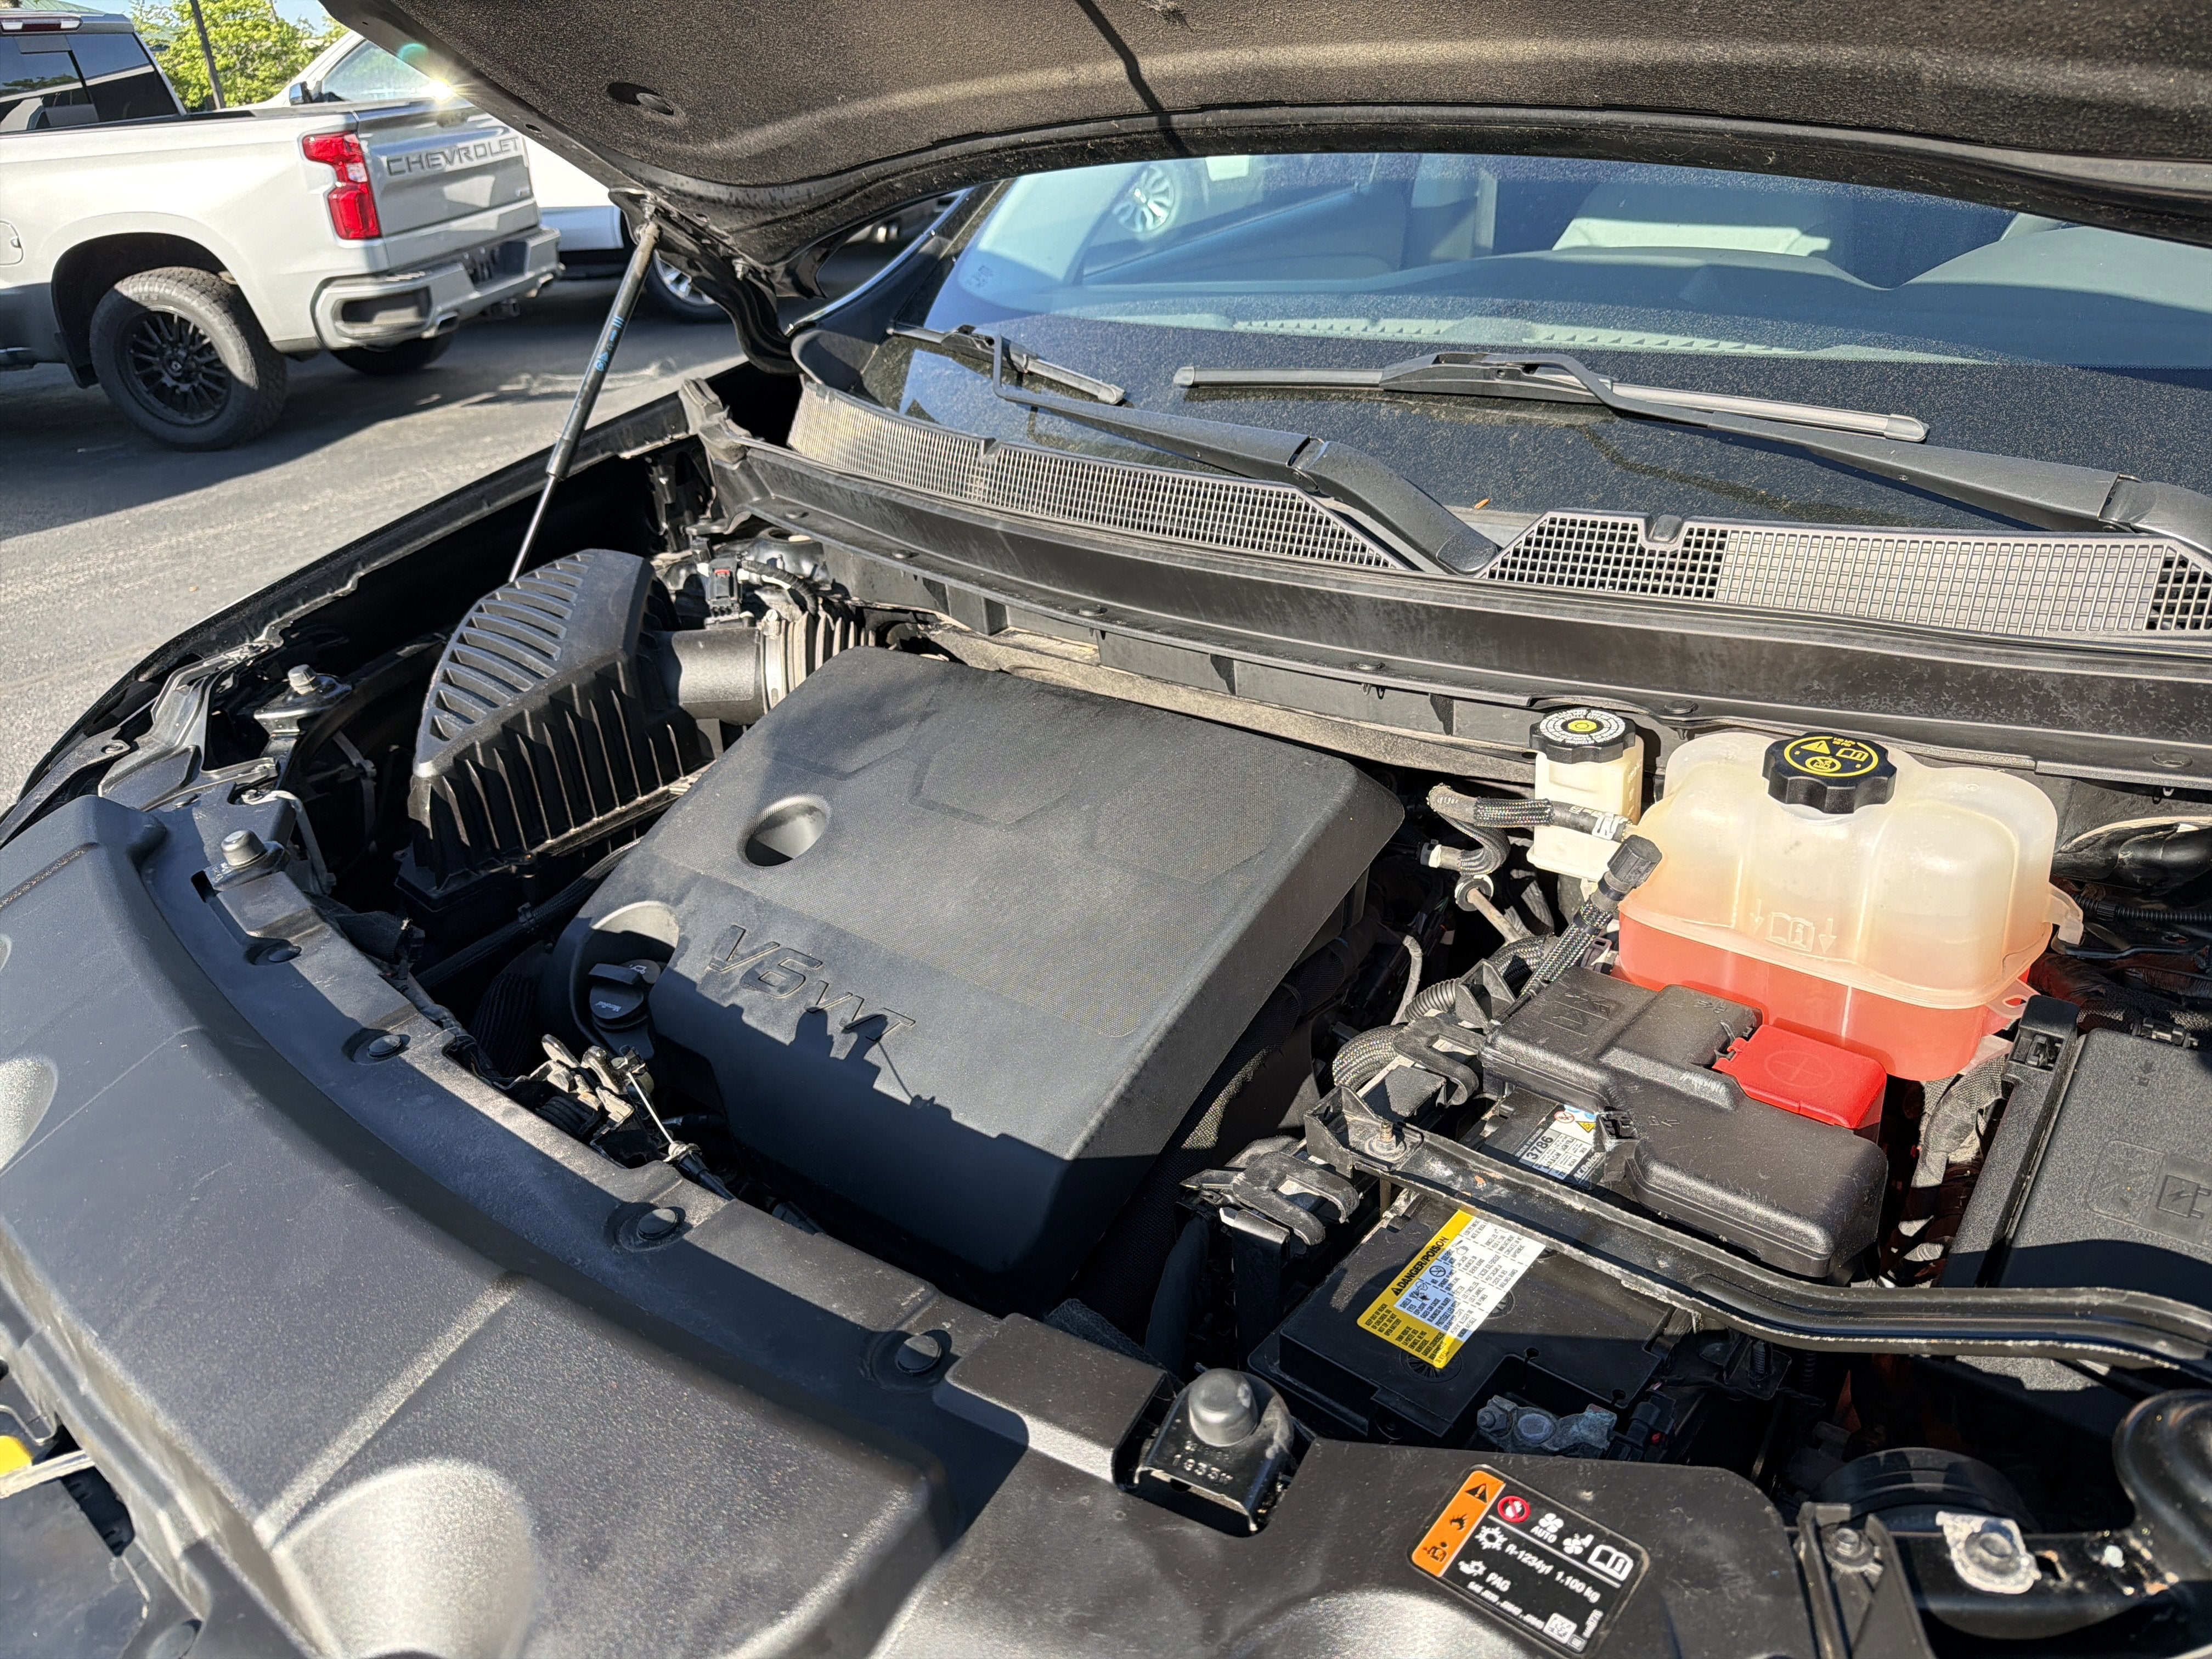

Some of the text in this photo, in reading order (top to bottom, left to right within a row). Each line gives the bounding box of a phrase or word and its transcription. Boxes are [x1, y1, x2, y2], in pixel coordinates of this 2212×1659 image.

[386, 137, 518, 175] CHEVROLET
[709, 924, 915, 1042] V6 VVT
[1525, 1135, 1553, 1160] 3786
[1573, 1151, 1601, 1181] ACDelco
[1396, 1235, 1449, 1289] DANGER/POISON
[1530, 1526, 1557, 1543] AUTO
[1485, 1572, 1511, 1592] PAG
[1505, 1544, 1600, 1603] R-1234yf 1.100 kg
